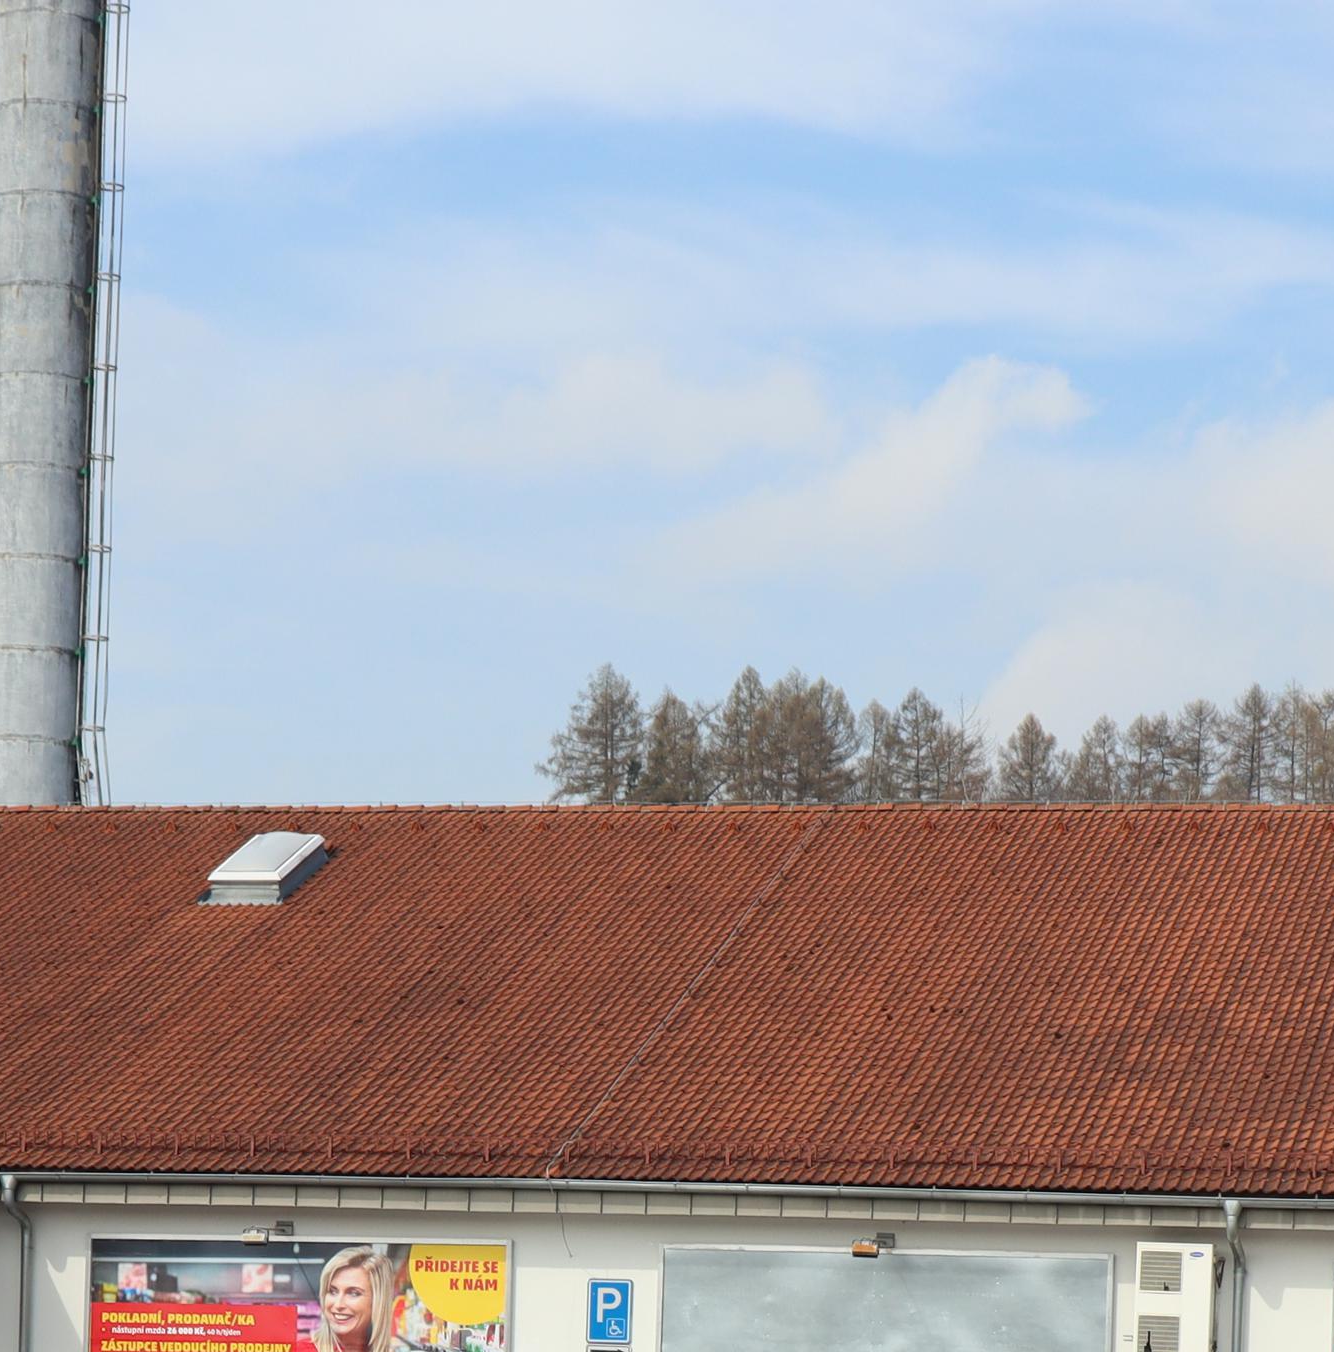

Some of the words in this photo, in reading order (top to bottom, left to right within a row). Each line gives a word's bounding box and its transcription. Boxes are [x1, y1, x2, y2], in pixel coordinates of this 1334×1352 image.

[415, 1256, 479, 1273] PŘIDEJTE
[482, 1261, 498, 1273] SE
[449, 1278, 459, 1291] K
[463, 1275, 498, 1291] NÁM
[596, 1287, 622, 1323] P
[101, 1310, 166, 1325] POKLADNÍ,
[167, 1312, 255, 1326] PRODAVAČ/KA
[111, 1326, 144, 1335] nástupní
[145, 1327, 166, 1335] mzda
[178, 1327, 193, 1335] 000
[101, 1338, 158, 1352] ZÁSTUPCE
